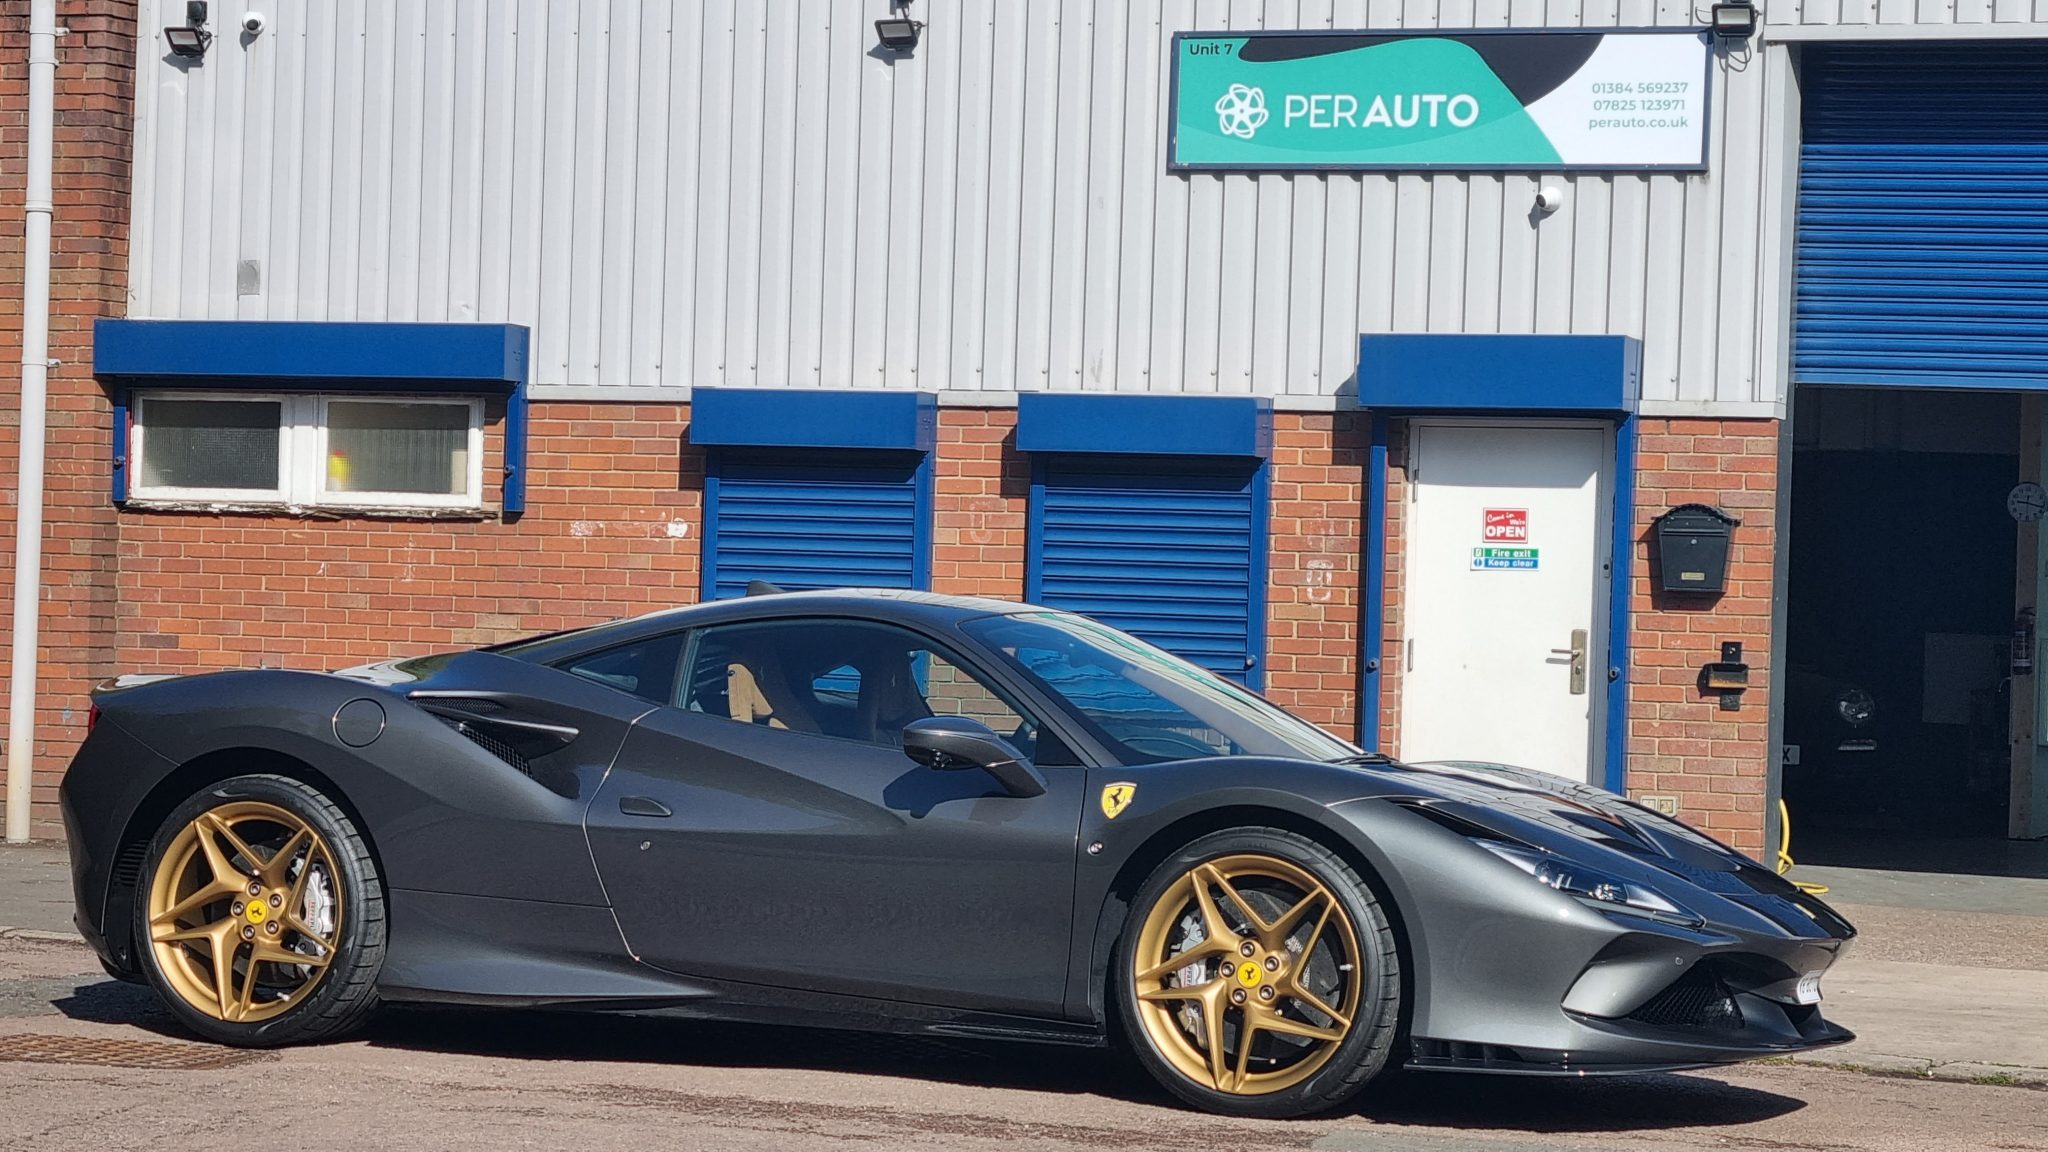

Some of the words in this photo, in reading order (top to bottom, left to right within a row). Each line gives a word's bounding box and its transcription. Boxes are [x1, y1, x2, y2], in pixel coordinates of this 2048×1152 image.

[1190, 42, 1220, 55] Unit
[1224, 43, 1233, 55] 7
[1592, 83, 1633, 94] 01384
[1637, 82, 1689, 94] 569237
[1593, 100, 1636, 111] 07825
[1641, 100, 1685, 111] 123971
[1589, 117, 1688, 130] perauto.co.uk
[1486, 525, 1525, 537] OPEN
[1491, 549, 1510, 558] Fire
[1513, 550, 1531, 558] exit
[1488, 559, 1510, 568] Keep
[1512, 560, 1534, 568] clear
